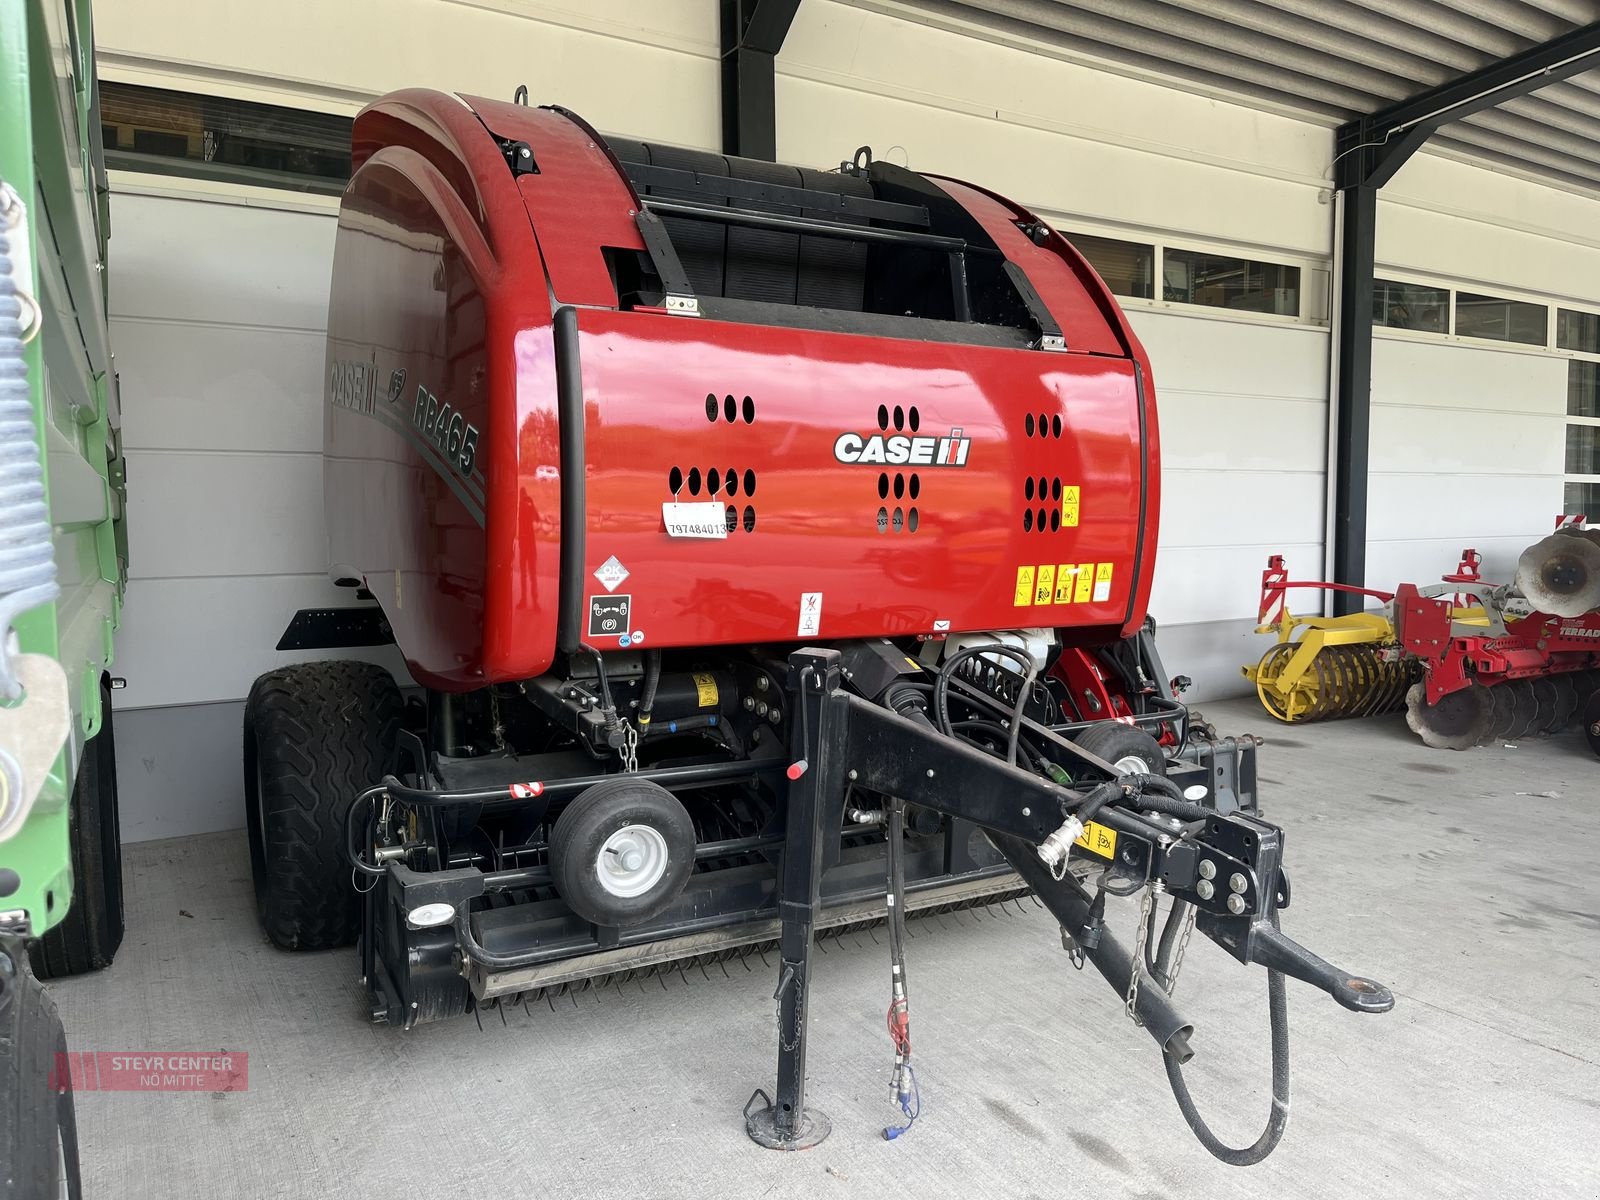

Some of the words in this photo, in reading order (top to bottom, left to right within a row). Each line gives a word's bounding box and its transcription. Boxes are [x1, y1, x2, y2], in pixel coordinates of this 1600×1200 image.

[413, 384, 480, 479] RB465
[668, 524, 728, 535] 797484013
[603, 565, 621, 575] OK
